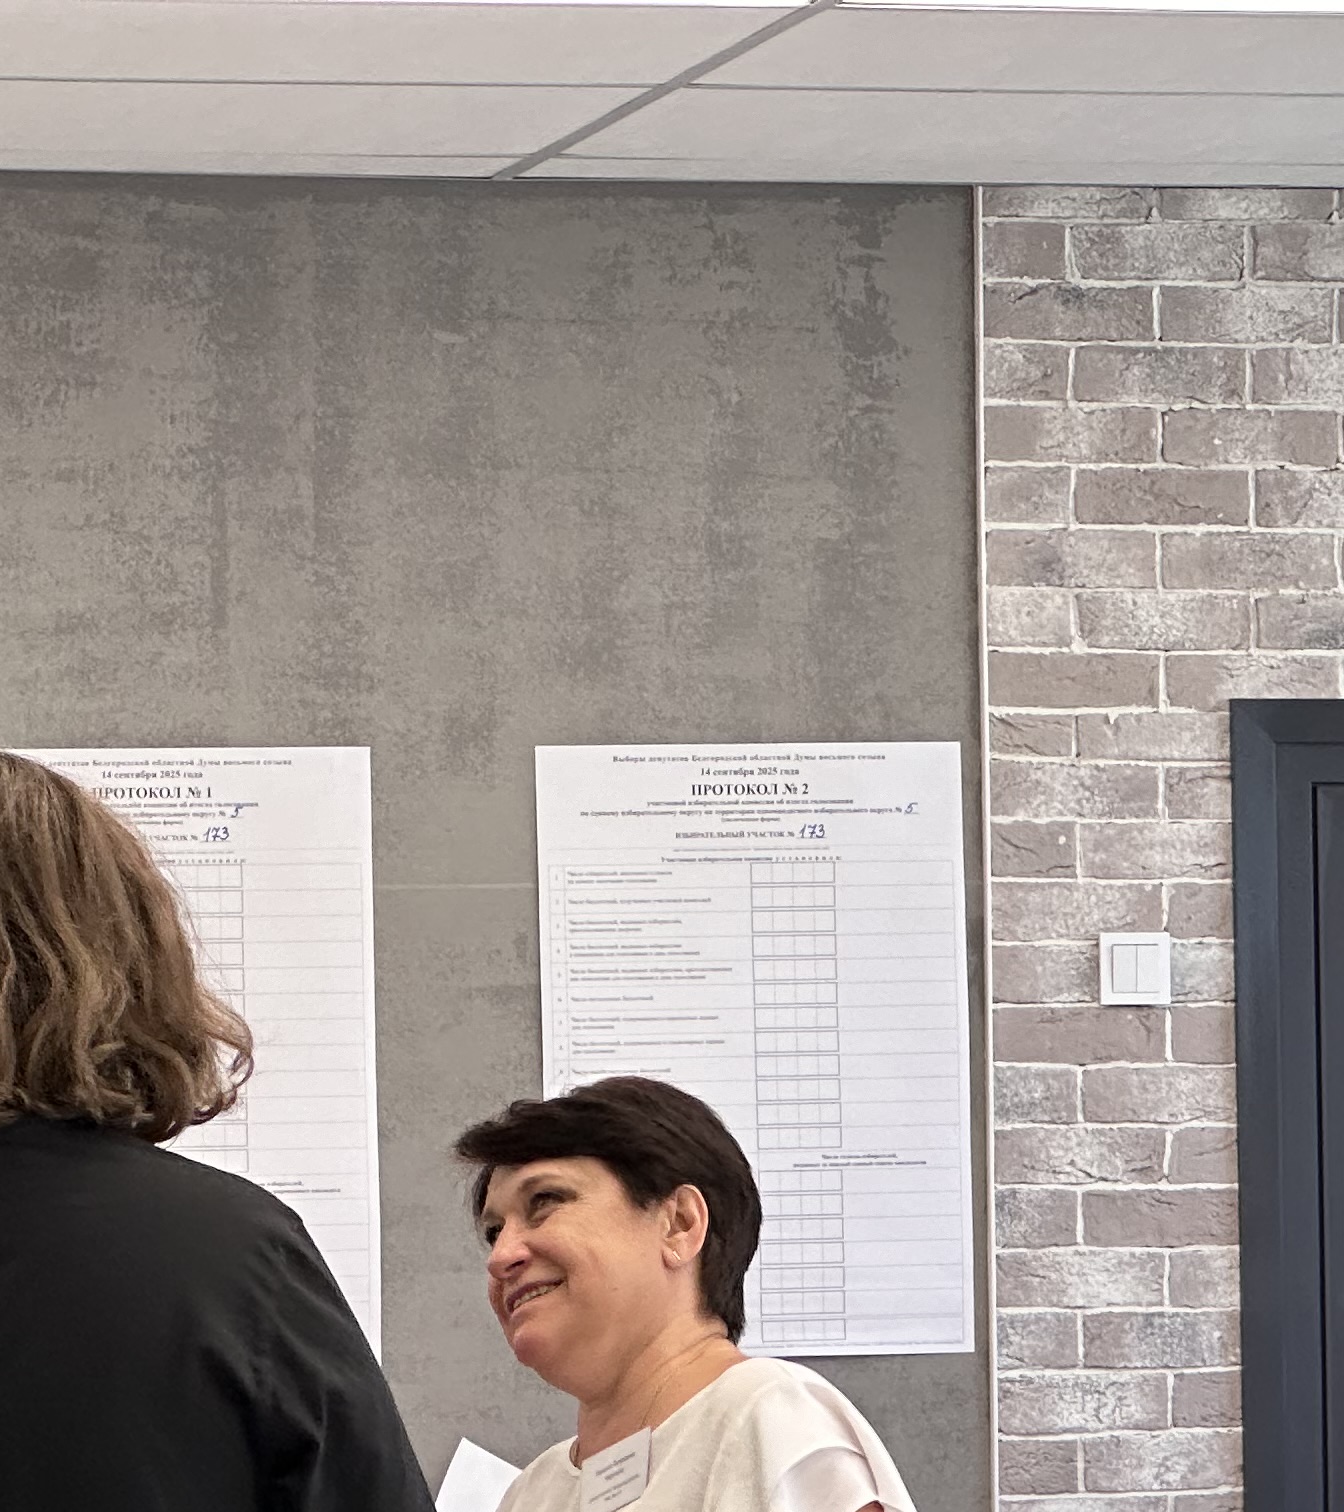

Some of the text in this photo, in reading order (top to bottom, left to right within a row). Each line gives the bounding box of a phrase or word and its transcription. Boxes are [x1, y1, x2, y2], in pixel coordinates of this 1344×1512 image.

[160, 770, 180, 778] 2025
[713, 768, 754, 776] сентября
[758, 767, 777, 775] 2025
[92, 786, 211, 799] ПРОТОКОЛ № 1
[692, 783, 808, 795] ПРОТОКОЛ № 2
[904, 801, 919, 815] 5
[203, 827, 229, 842] 173
[799, 824, 825, 839] 173
